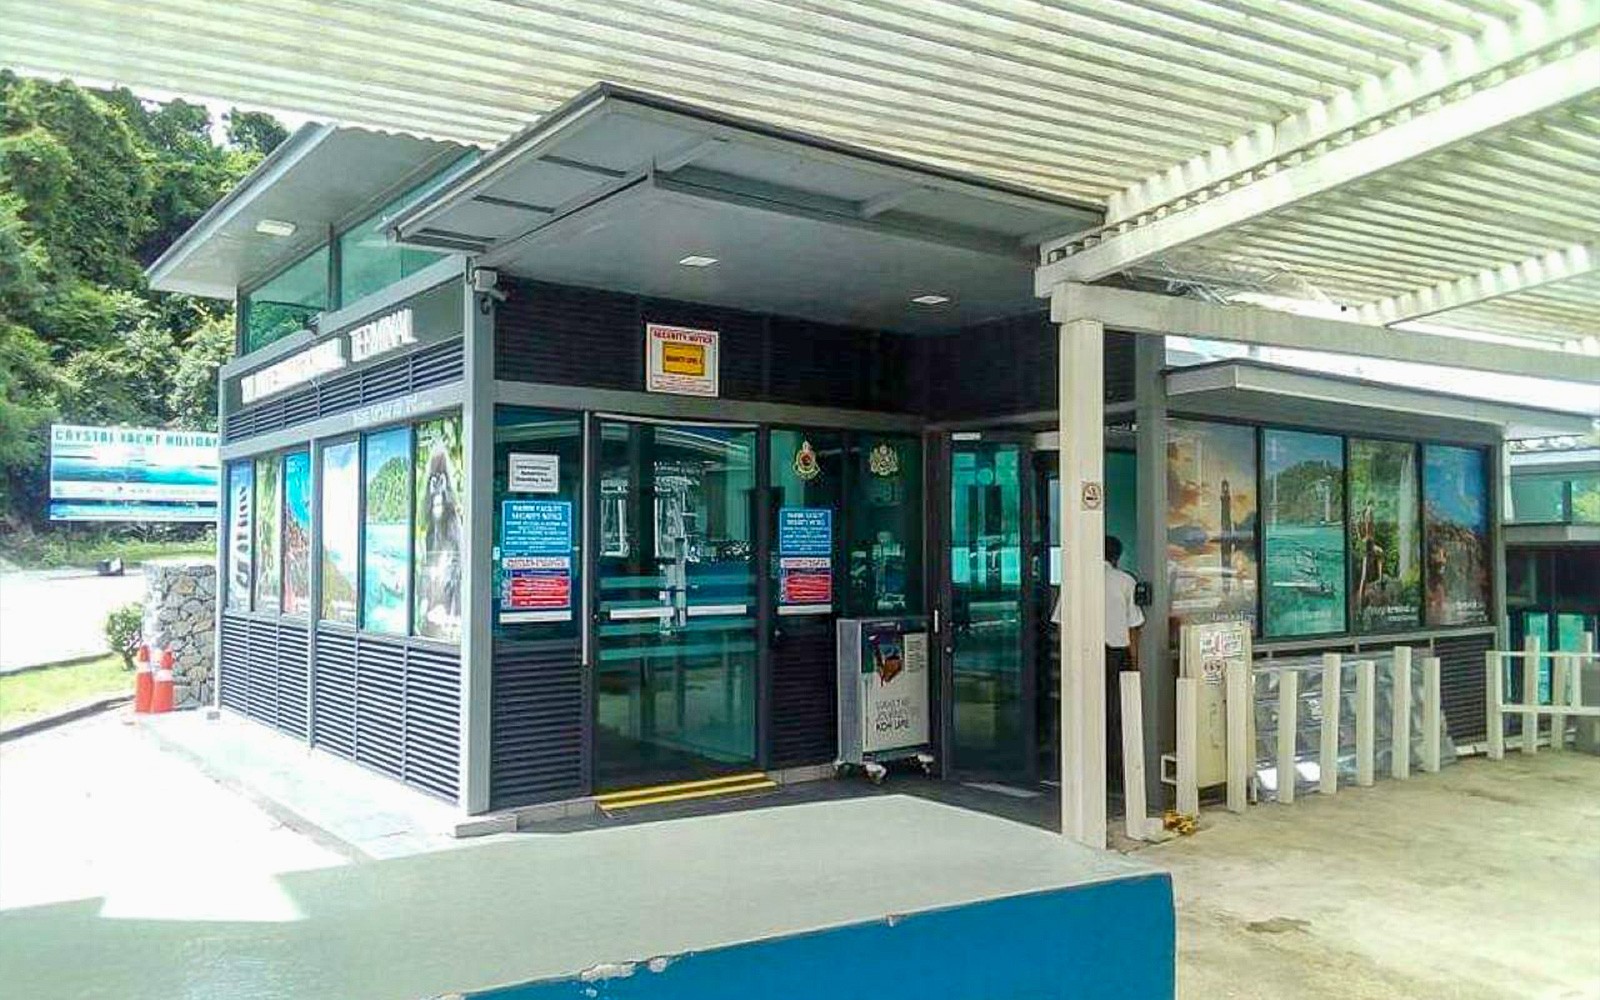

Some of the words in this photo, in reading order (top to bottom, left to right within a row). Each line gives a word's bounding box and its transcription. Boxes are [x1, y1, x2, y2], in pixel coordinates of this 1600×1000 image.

[350, 309, 417, 362] TERMINAL
[653, 329, 687, 341] SECURITY
[55, 429, 114, 444] CRYSTAL
